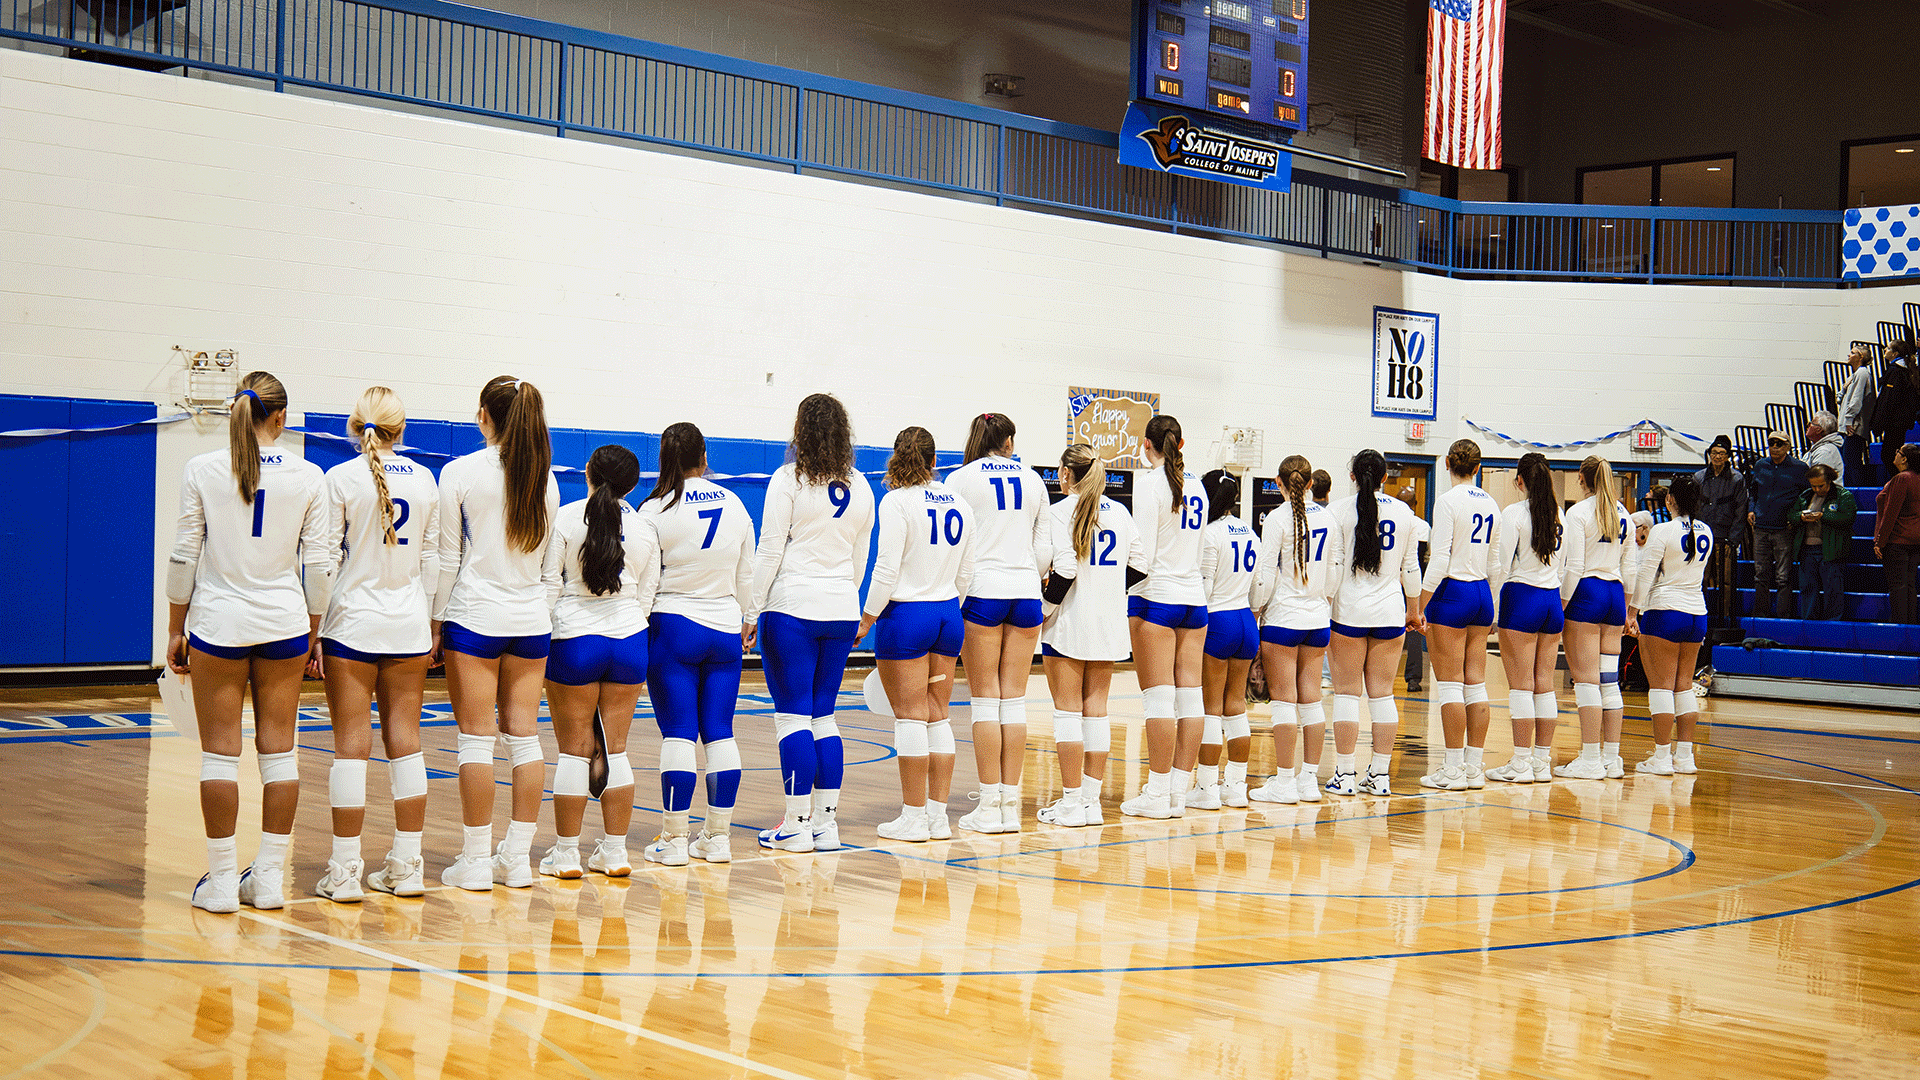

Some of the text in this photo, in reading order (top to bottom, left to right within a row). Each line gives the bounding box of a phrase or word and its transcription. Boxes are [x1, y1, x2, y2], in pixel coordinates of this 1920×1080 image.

[1216, 0, 1247, 20] period
[1167, 42, 1179, 71] 0
[1159, 79, 1179, 96] won
[1283, 70, 1295, 97] 0
[1217, 92, 1241, 109] game
[1278, 105, 1296, 121] won
[1182, 131, 1276, 167] SAINT JOSEPH'S
[1184, 157, 1260, 177] COLLEGE OF MAINE
[1388, 328, 1425, 365] NO
[1387, 363, 1424, 400] H8
[1092, 401, 1130, 431] Happy
[1080, 421, 1139, 456] Senior Day
[1638, 432, 1658, 447] EXIT
[260, 455, 283, 464] NKS
[384, 464, 413, 473] ONKS
[685, 490, 725, 502] MONKS
[828, 480, 851, 518] 9
[925, 490, 954, 501] MONKS
[989, 477, 1023, 511] 11
[252, 489, 265, 537] 1
[383, 498, 410, 545] 2
[927, 508, 964, 546] 10
[1181, 495, 1203, 530] 13
[697, 507, 723, 550] 7
[1470, 513, 1494, 544] 21
[1090, 529, 1118, 566] 12
[1231, 540, 1257, 573] 16
[1680, 534, 1710, 562] 99
